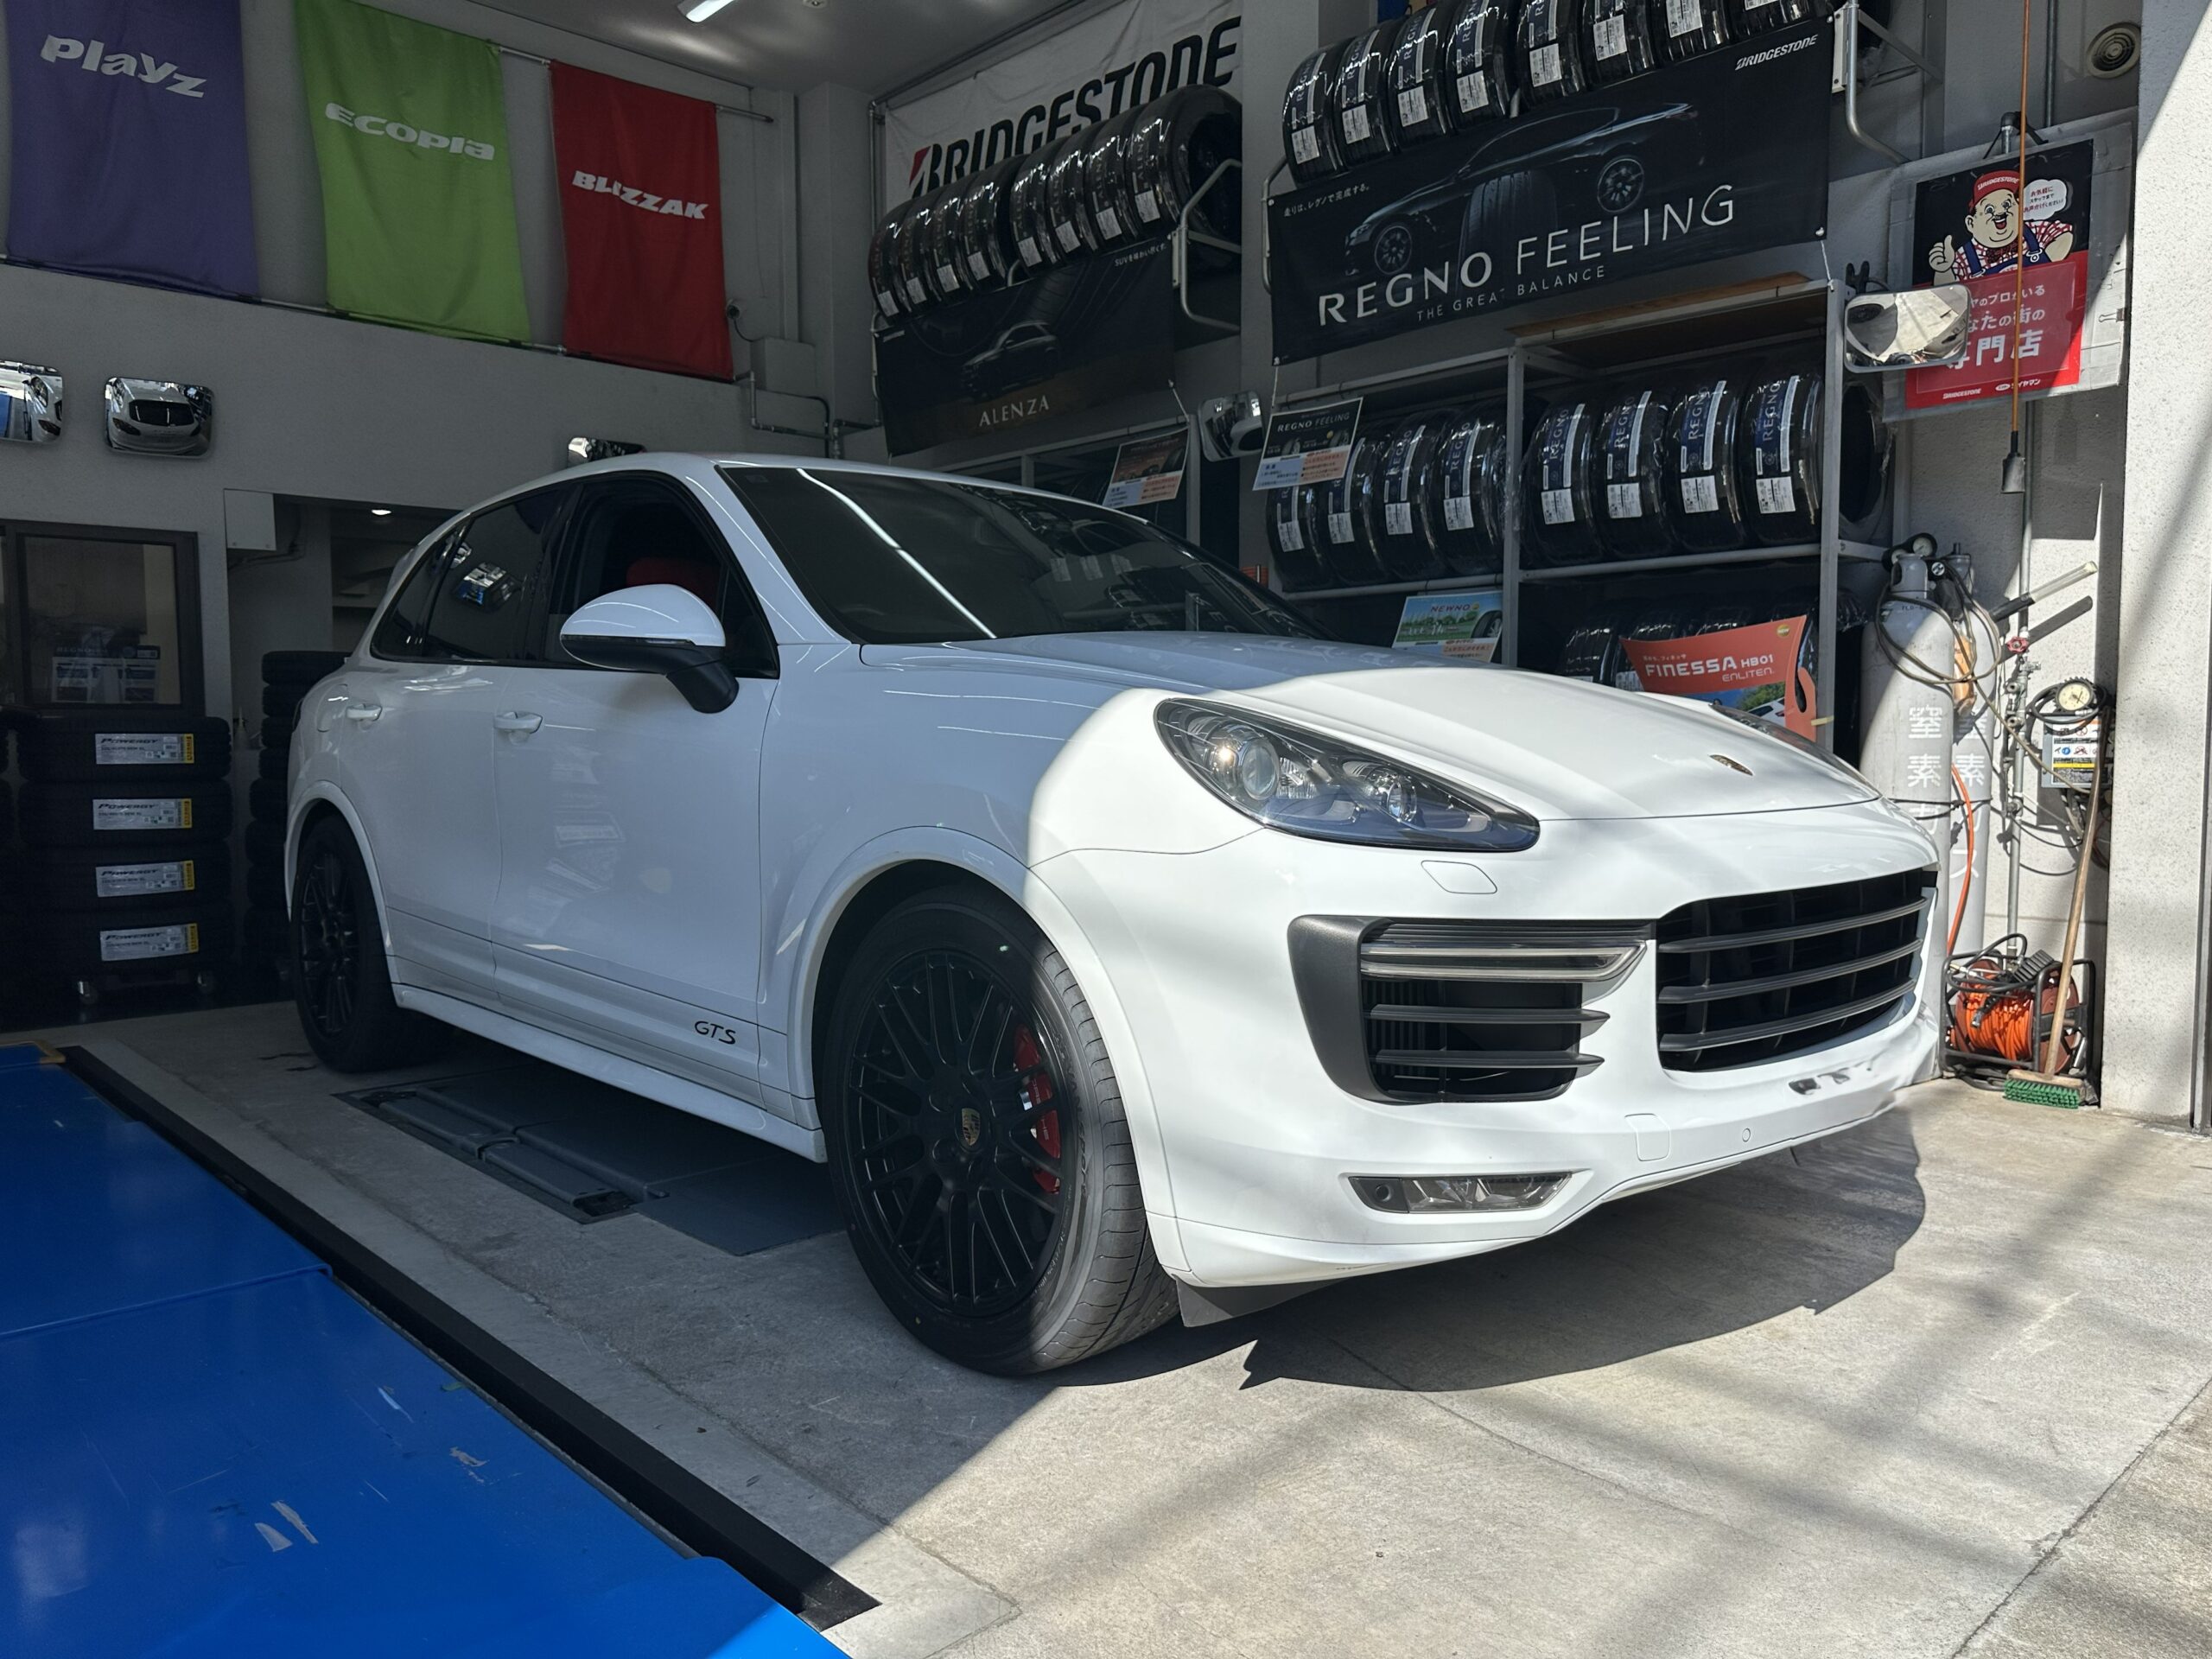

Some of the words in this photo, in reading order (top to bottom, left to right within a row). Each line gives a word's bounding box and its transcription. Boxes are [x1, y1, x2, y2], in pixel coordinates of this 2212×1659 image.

[40, 34, 207, 99] Playz
[1735, 34, 1819, 71] BRIDGESTONE
[909, 16, 1242, 199] BRIDGESTONE
[572, 170, 709, 219] BLIZZAK
[1977, 176, 2019, 190] BRIDGESTONE
[1319, 251, 1492, 326] REGNO
[1516, 185, 1733, 275] FEELING
[1417, 304, 1444, 321] THE
[1517, 265, 1605, 296] BALANCE
[1968, 304, 2045, 333] なたの街の
[1948, 329, 2044, 369] 門店
[979, 395, 1049, 427] ALENZA
[1277, 420, 1313, 432] REGNO
[1314, 412, 1350, 426] FEELING
[1763, 383, 1781, 442] REGNO
[1430, 603, 1471, 613] NEWNO
[1645, 656, 1738, 677] FINESSA
[1741, 654, 1774, 668] HB01
[695, 1020, 736, 1044] GTS
